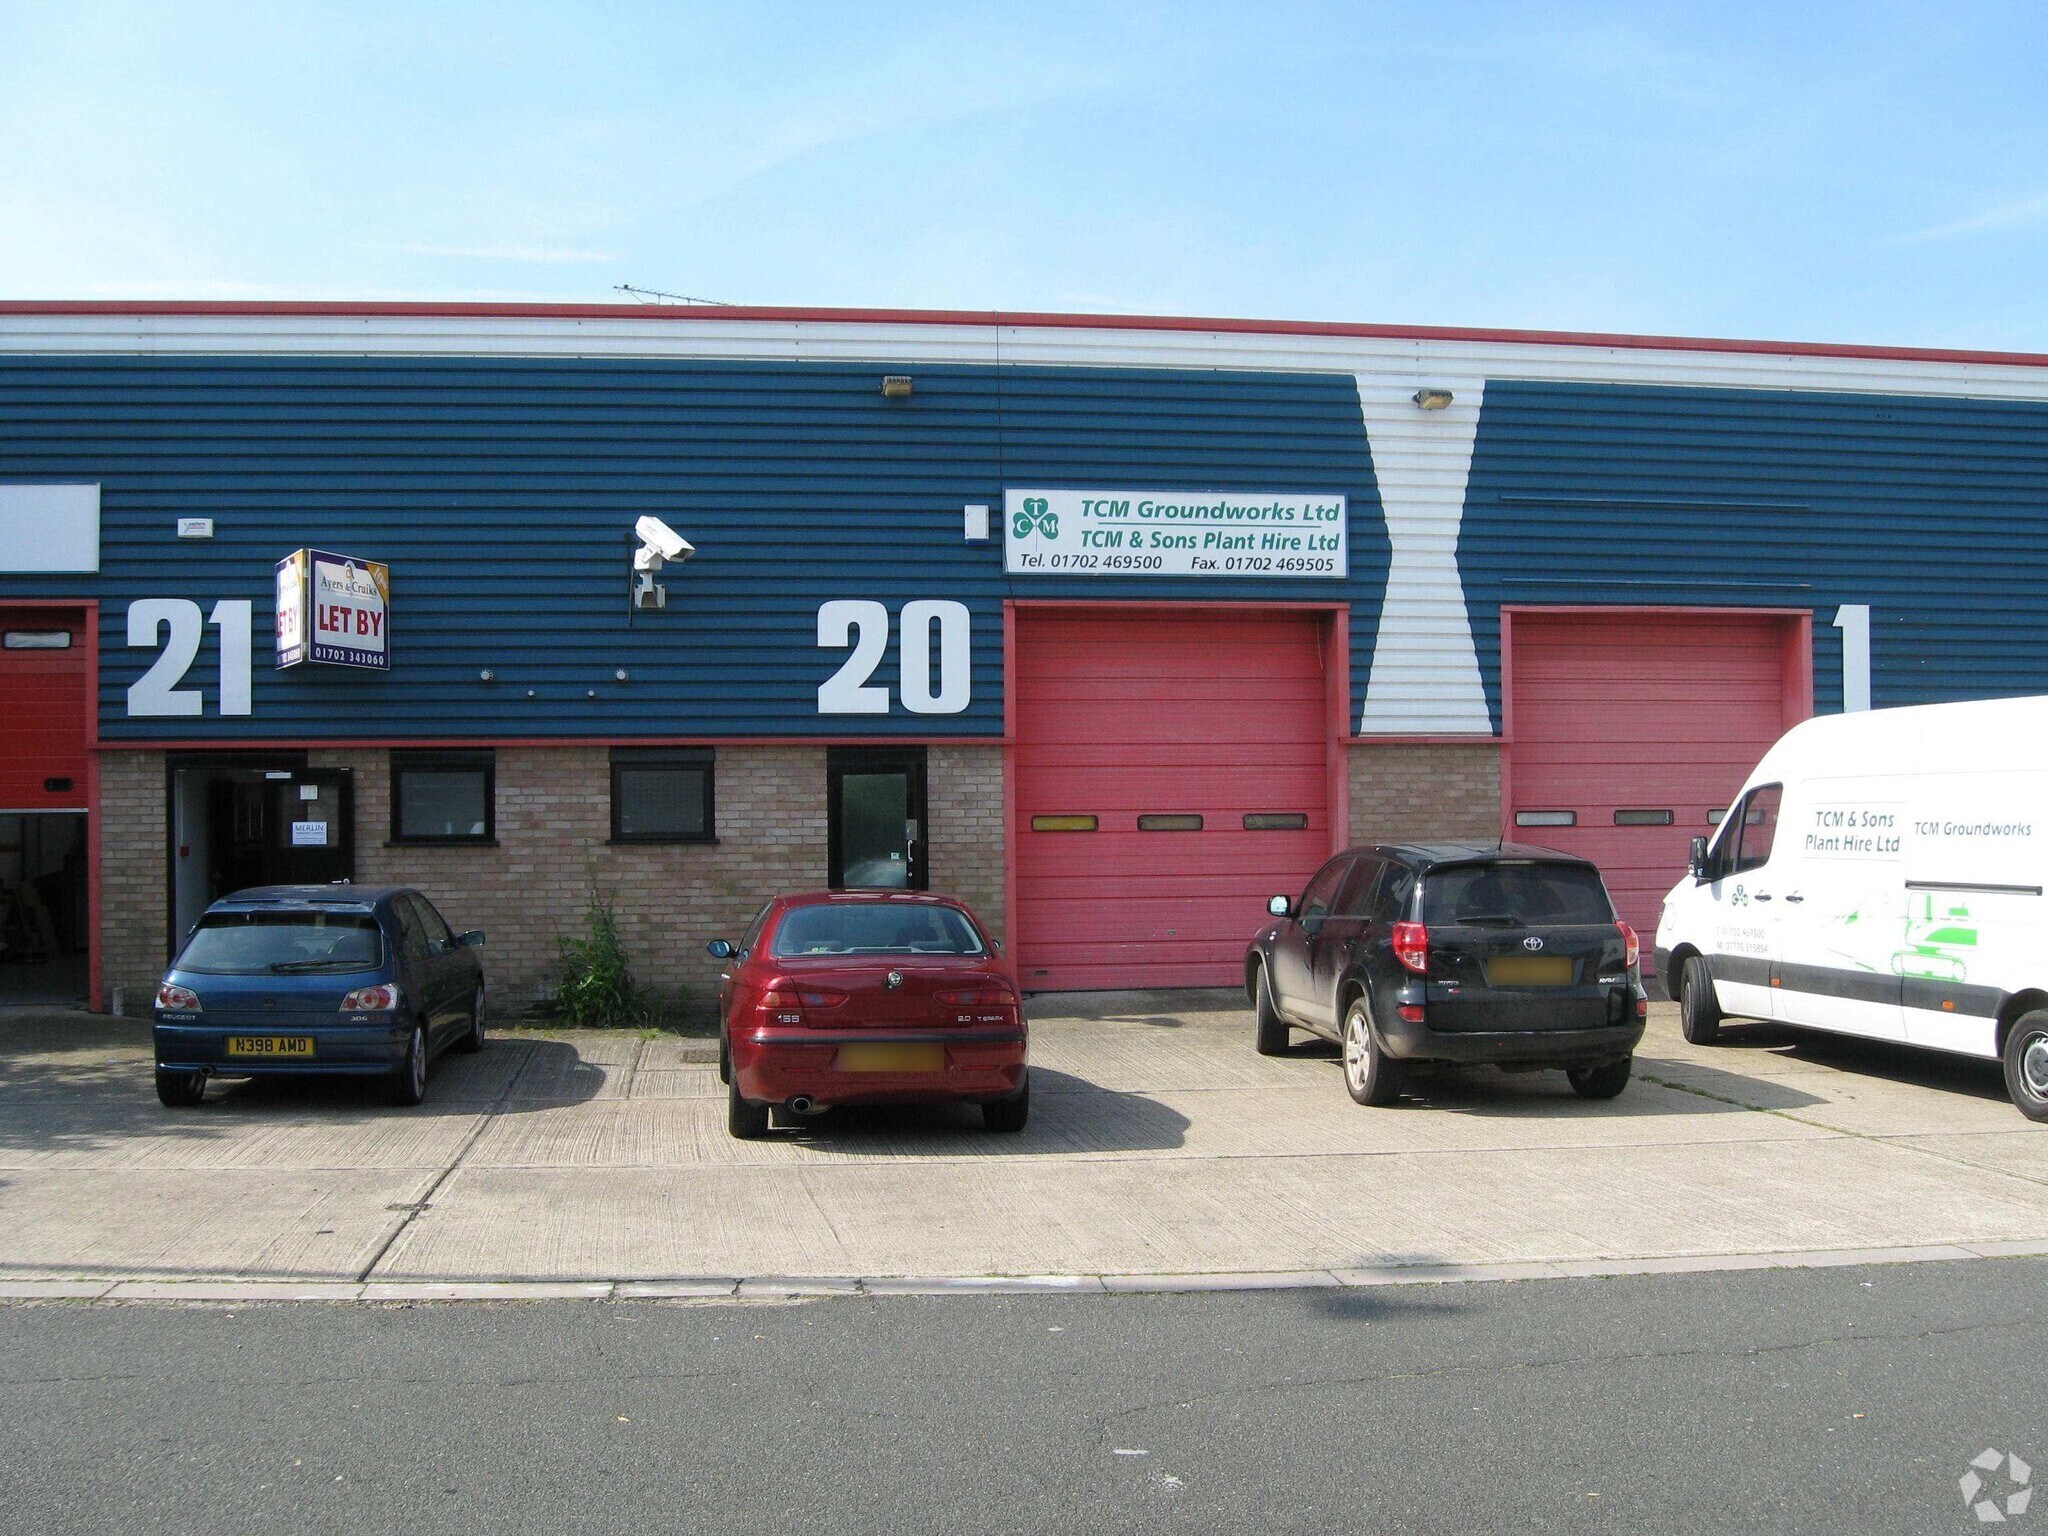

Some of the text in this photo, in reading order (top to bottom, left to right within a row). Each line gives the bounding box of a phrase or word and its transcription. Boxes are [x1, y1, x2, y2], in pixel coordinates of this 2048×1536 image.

[1029, 501, 1042, 516] T
[1081, 499, 1340, 522] TCM Groundworks Ltd
[1016, 518, 1057, 534] C M
[1081, 530, 1341, 551] TCM & Sons Plant Hire Ltd
[1020, 553, 1335, 572] Tel. 01702 469500 Fax. 01702 469505
[321, 576, 344, 592] Ayers
[319, 603, 383, 637] LET BY
[127, 599, 253, 716] 21
[315, 647, 345, 661] 01702
[349, 651, 384, 666] 343060
[817, 600, 971, 714] 20
[1832, 603, 1871, 714] 1
[1816, 810, 1895, 827] TCM & Sons
[295, 824, 324, 832] MERLIN
[1915, 821, 2033, 836] TCM Groundworks
[1805, 834, 1901, 852] Plant Hire Ltd
[236, 1038, 274, 1053] N398
